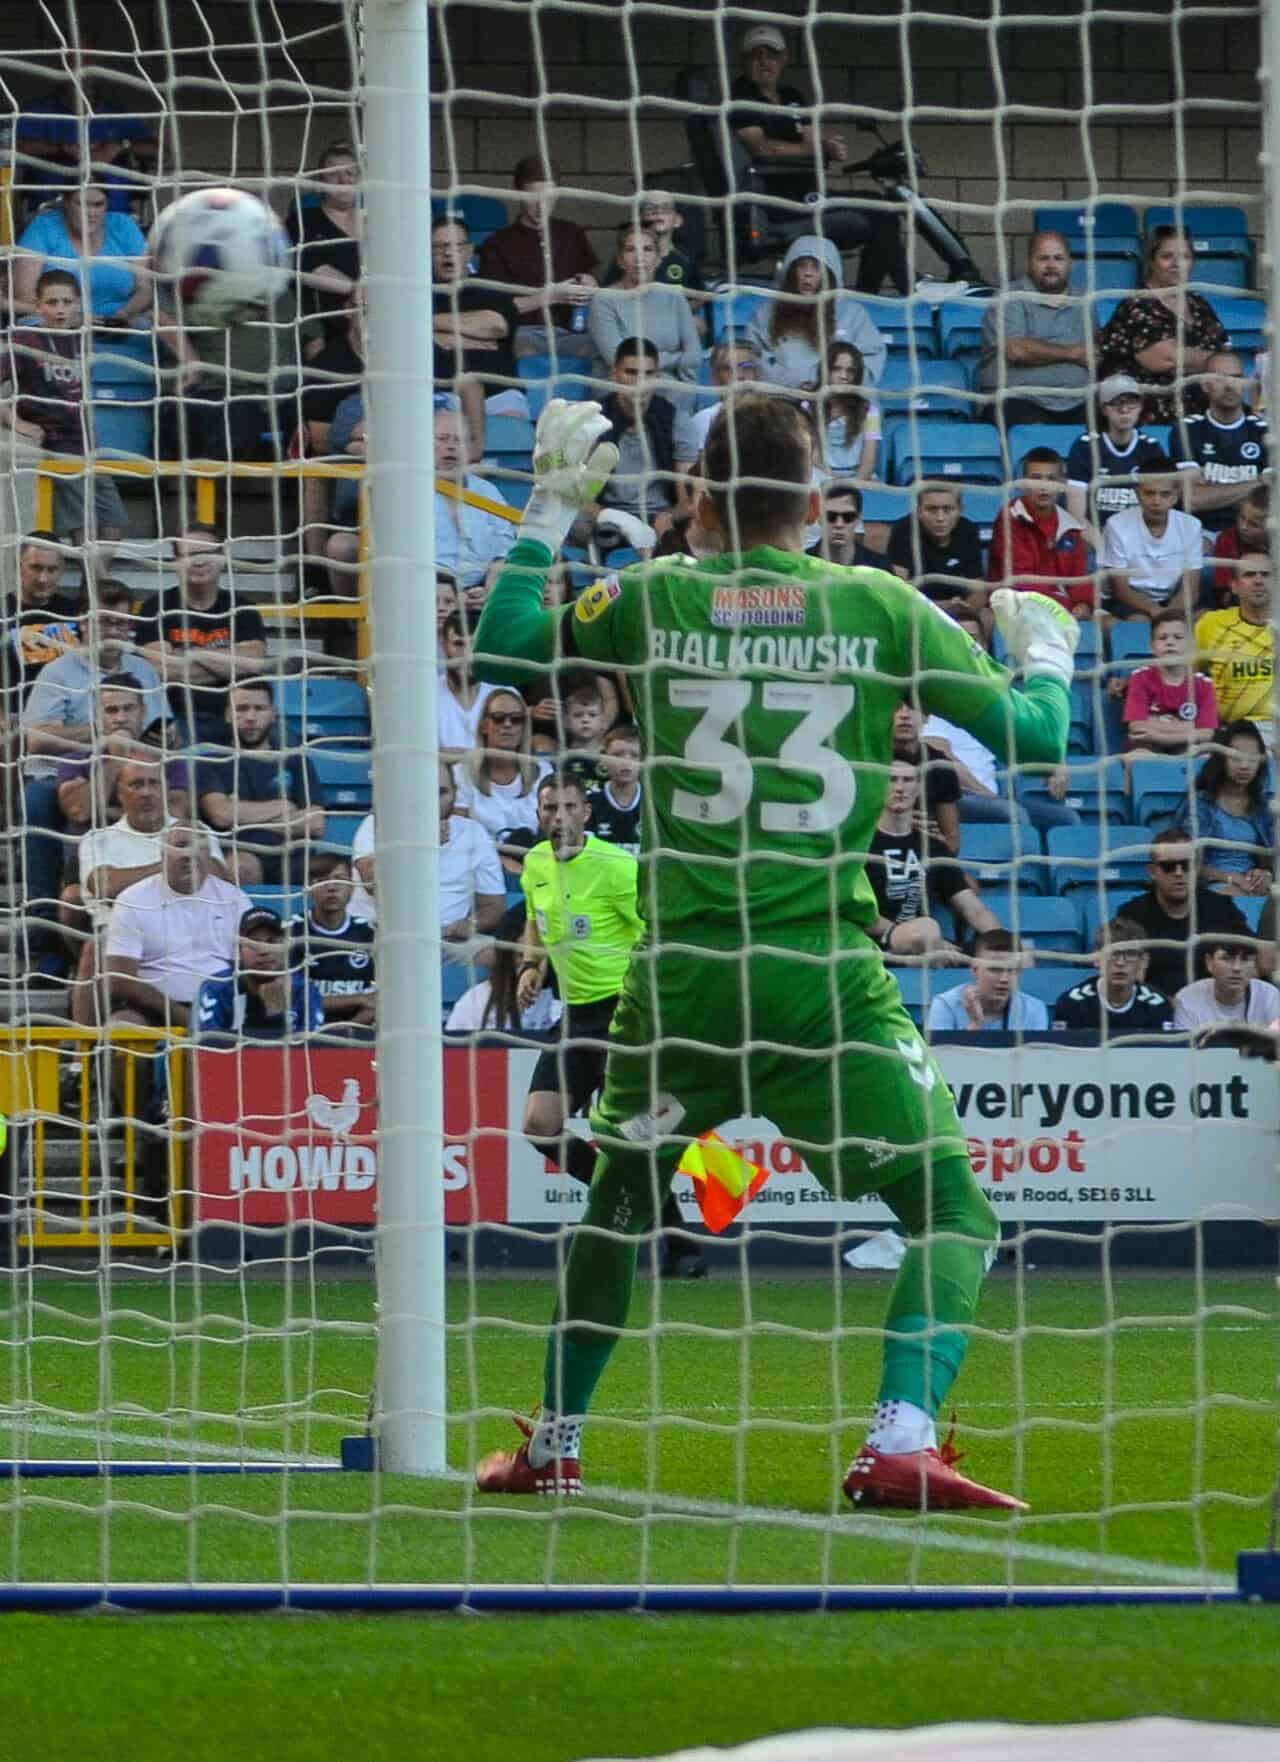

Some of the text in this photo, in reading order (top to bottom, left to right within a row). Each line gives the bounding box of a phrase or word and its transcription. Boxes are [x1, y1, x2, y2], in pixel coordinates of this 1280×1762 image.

[713, 608, 806, 625] SCFFOLDING
[650, 629, 879, 673] BIALKOWSKI
[1232, 660, 1272, 678] HUS
[668, 680, 857, 833] 33
[948, 1075, 1249, 1128] veryone at
[229, 1145, 469, 1191] HOWDS
[967, 1130, 1086, 1182] epot
[545, 1189, 582, 1203] Unit
[753, 1189, 794, 1205] ding
[1023, 1188, 1073, 1203] Road,
[1078, 1188, 1120, 1202] SE16
[1125, 1188, 1155, 1202] 3LL
